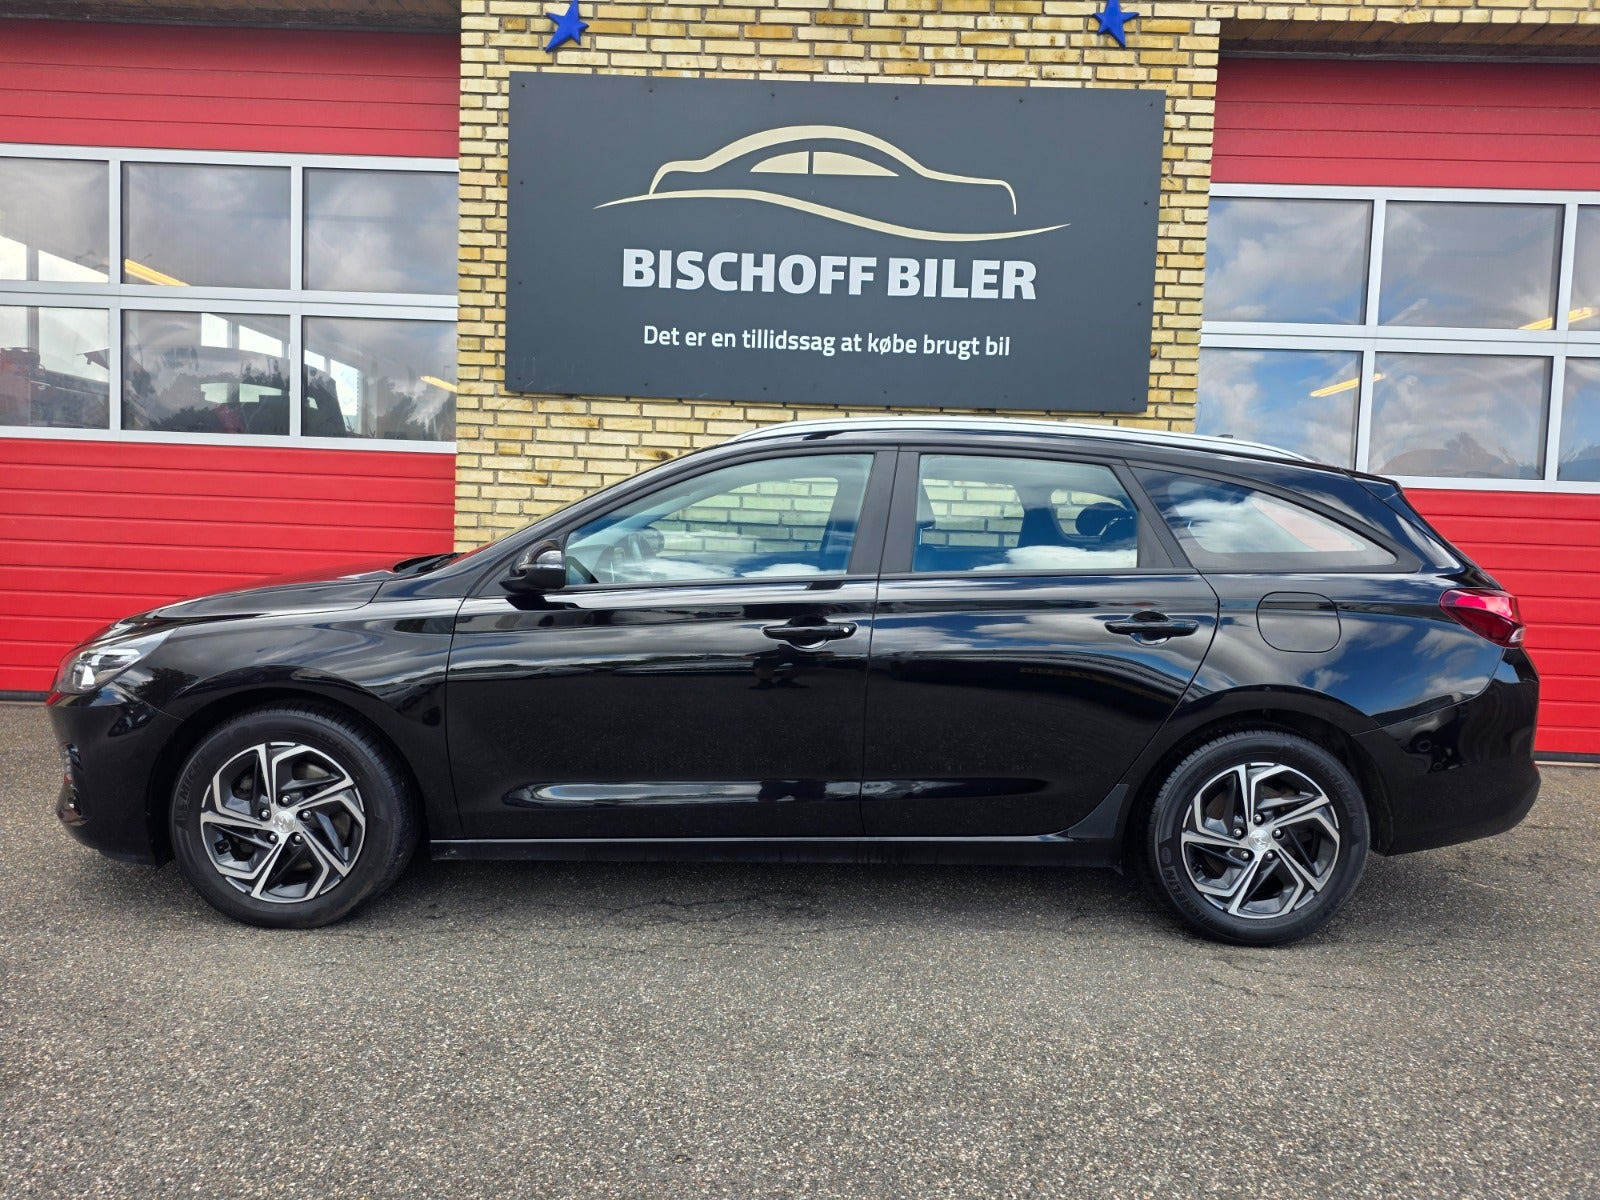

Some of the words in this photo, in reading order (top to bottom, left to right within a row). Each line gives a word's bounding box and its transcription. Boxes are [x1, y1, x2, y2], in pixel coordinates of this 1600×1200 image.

[623, 249, 877, 297] BISCHOFF
[888, 257, 1037, 300] BILER
[643, 325, 680, 346] Det
[686, 332, 707, 347] er
[712, 333, 737, 348] en
[742, 328, 837, 357] tillidssag
[841, 333, 864, 353] at
[868, 332, 919, 355] købe
[924, 334, 981, 362] brugt
[986, 335, 1011, 357] bil
